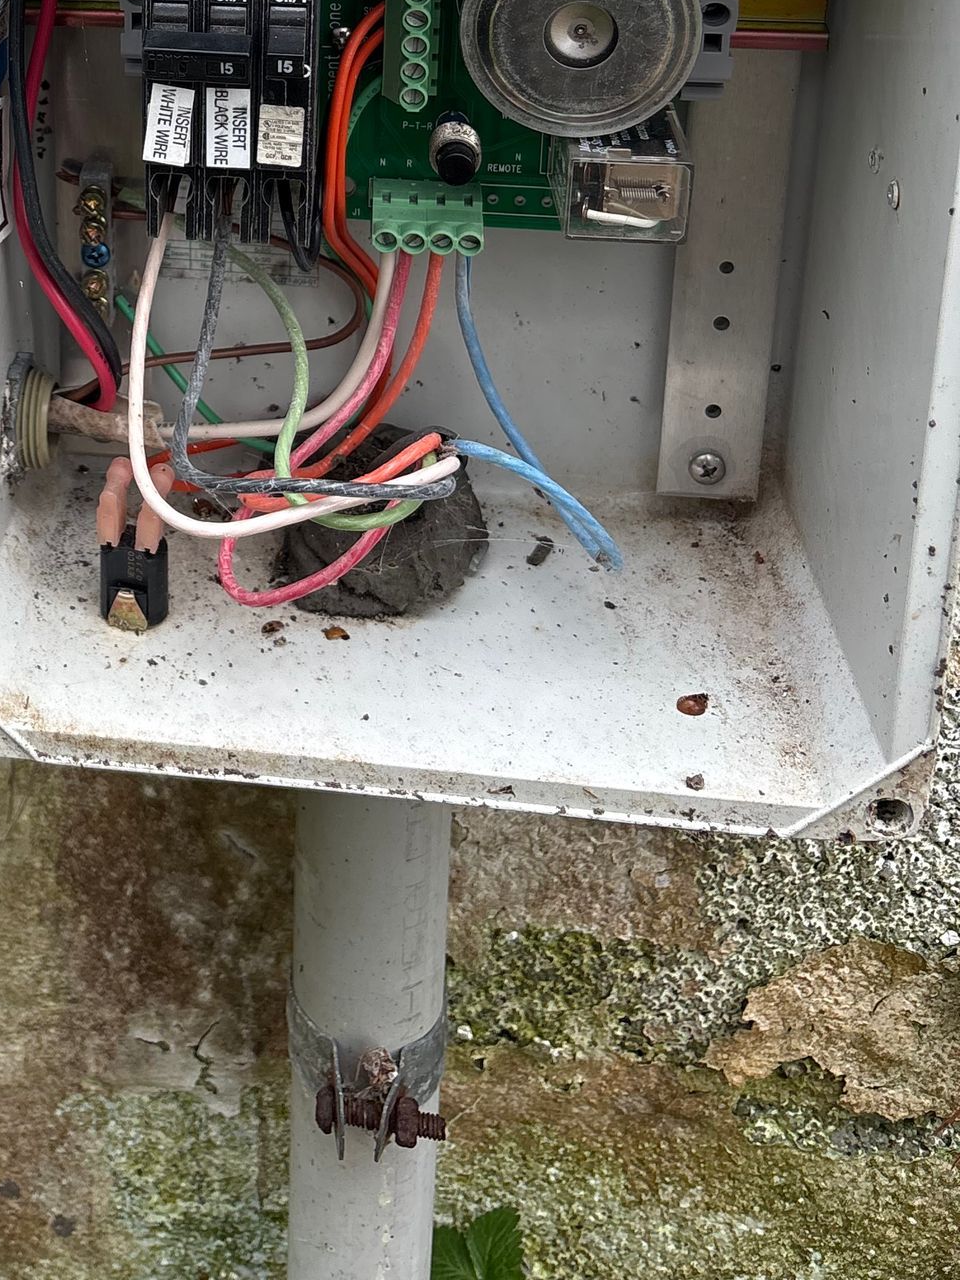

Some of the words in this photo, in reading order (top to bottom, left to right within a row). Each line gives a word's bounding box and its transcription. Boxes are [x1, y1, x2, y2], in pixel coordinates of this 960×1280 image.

[220, 62, 234, 74] 15
[277, 60, 293, 73] 15
[158, 89, 177, 126] WHITE
[214, 89, 228, 131] BLACK
[172, 105, 191, 148] INSERT
[232, 107, 248, 151] INSERT
[402, 121, 433, 131] P-T-R
[153, 128, 170, 160] WIRE
[214, 135, 228, 166] WIRE
[379, 158, 386, 166] N
[515, 153, 522, 161] N
[406, 159, 413, 168] R
[487, 163, 522, 174] REMOTE
[352, 208, 361, 216] J1
